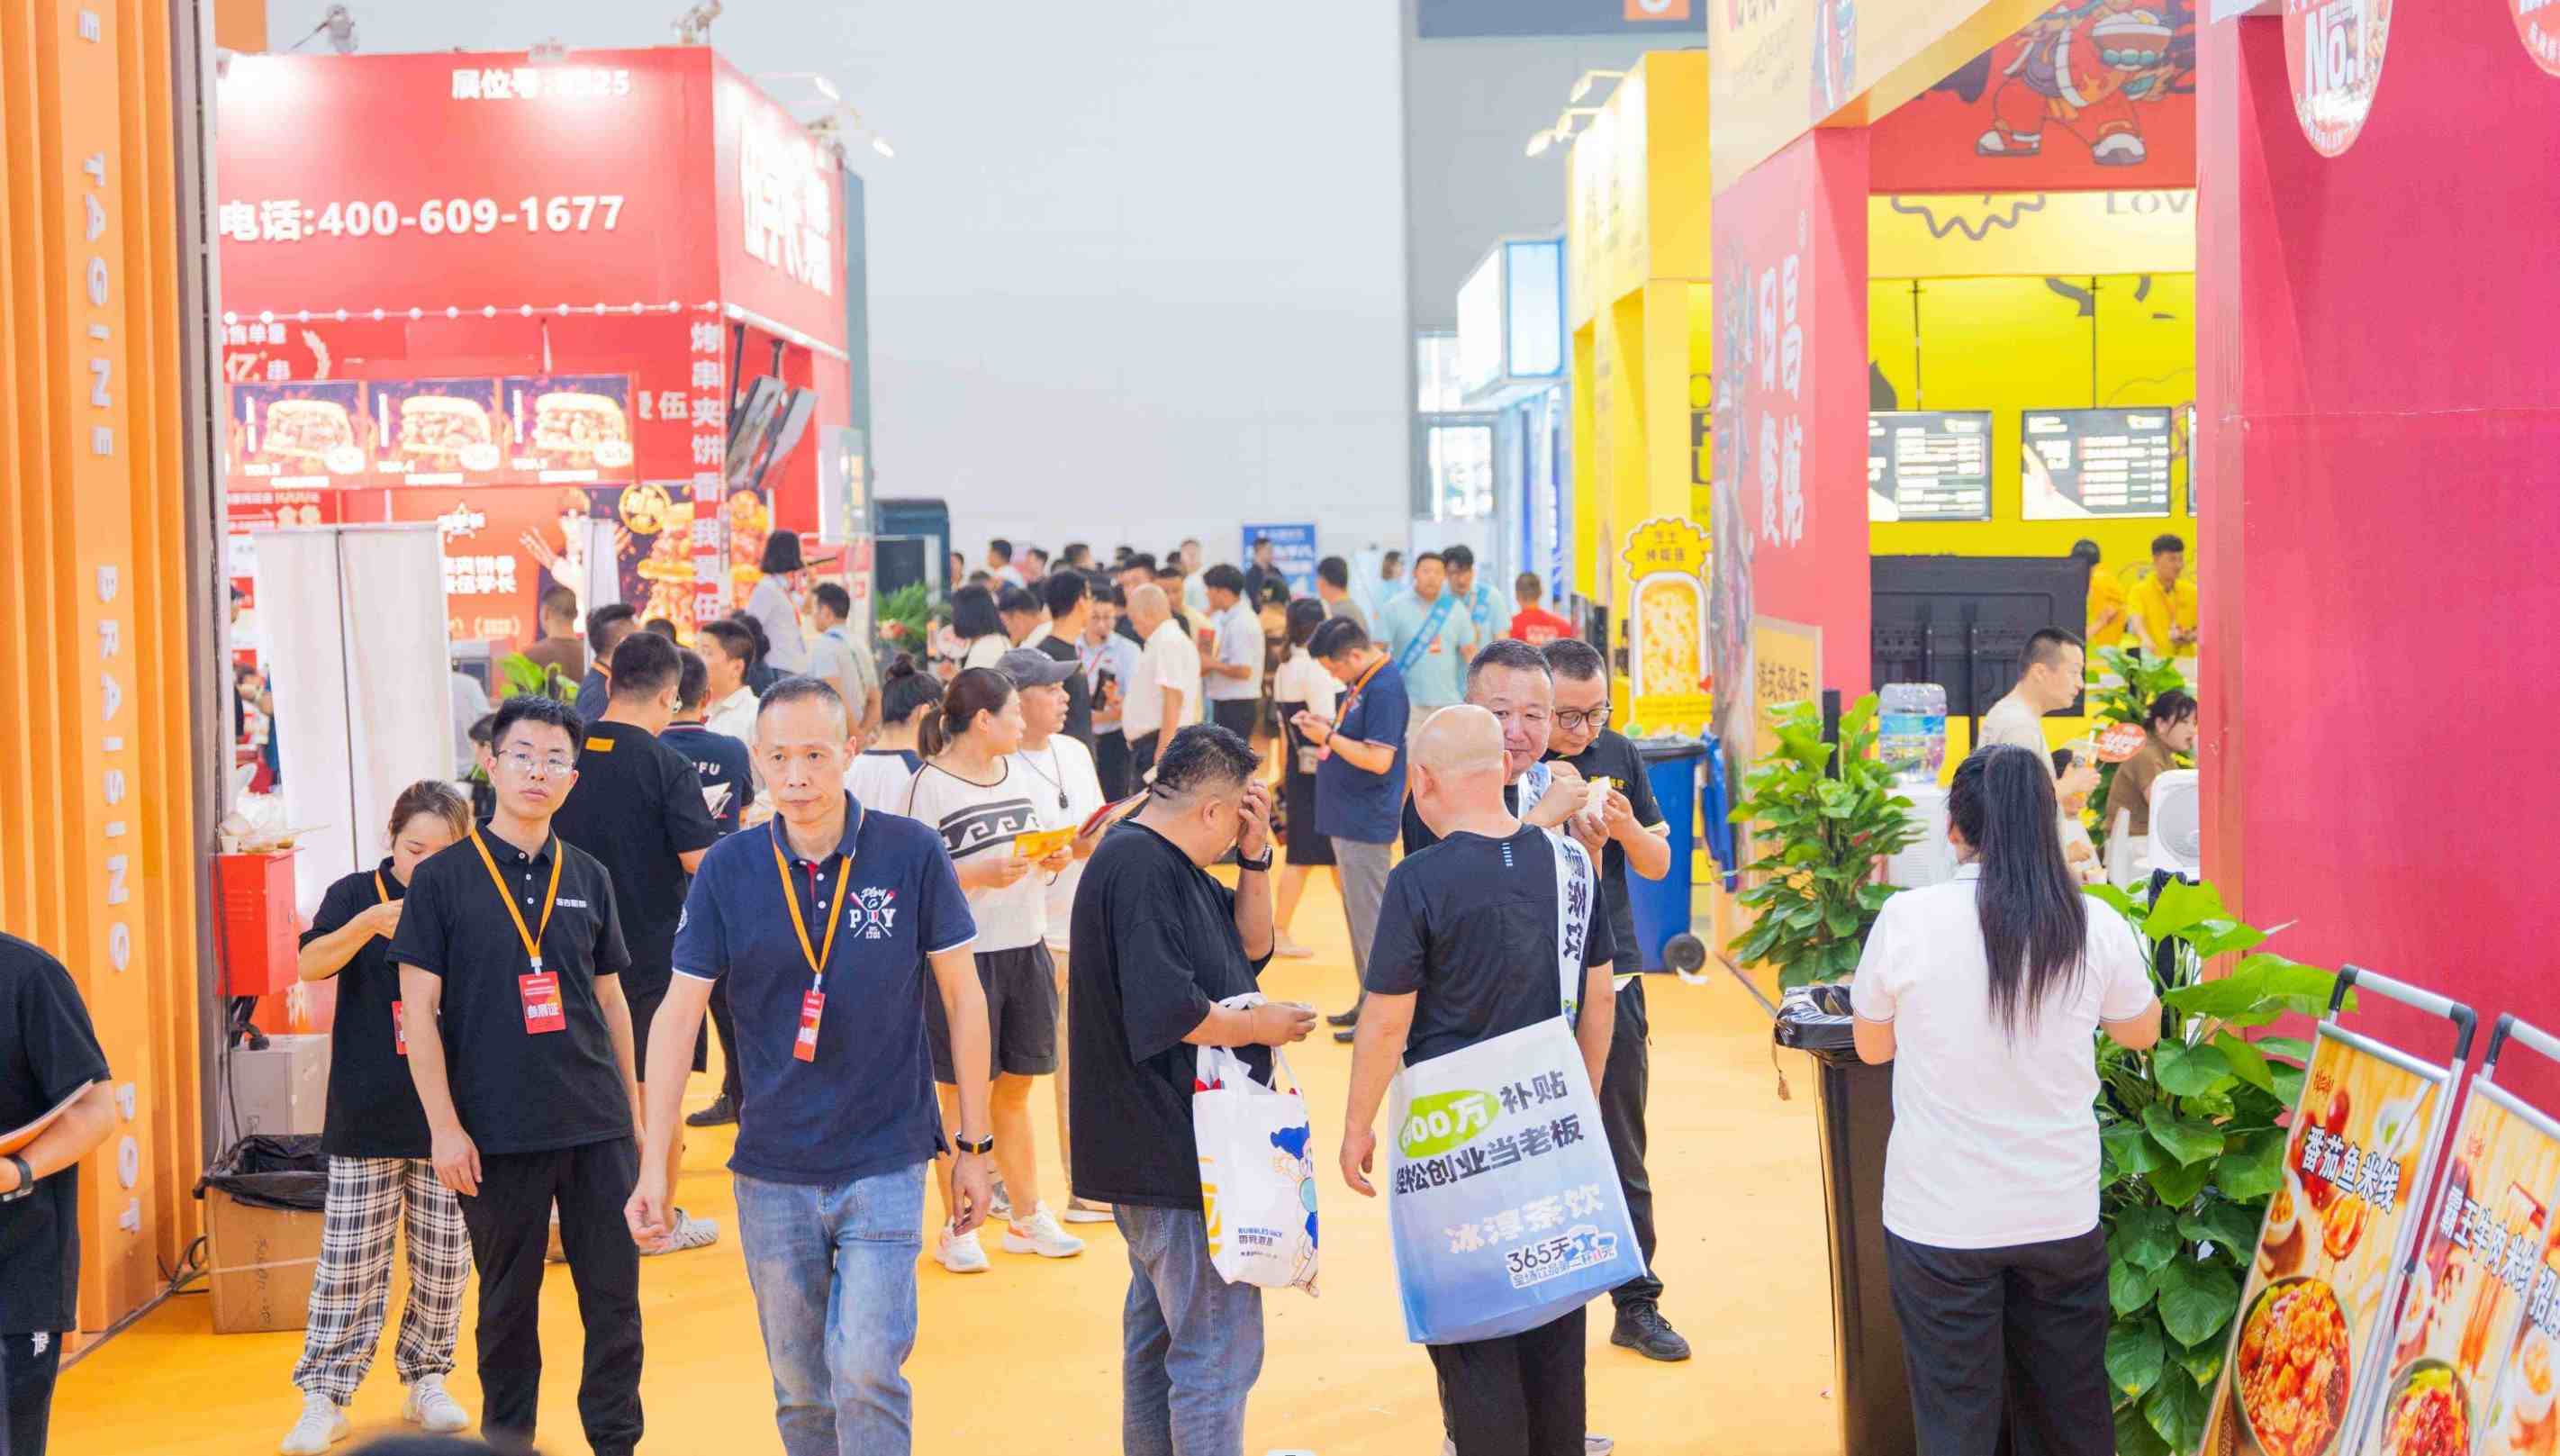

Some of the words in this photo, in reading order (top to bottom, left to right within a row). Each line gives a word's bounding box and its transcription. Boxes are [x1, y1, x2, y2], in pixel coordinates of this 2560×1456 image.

[82, 153, 113, 456] TAGINE
[95, 565, 131, 972] BRAISING
[692, 761, 720, 776] FU
[1499, 1070, 1569, 1115] 补贴
[114, 1083, 140, 1232] POT
[2302, 1125, 2401, 1216] 番茄鱼米线
